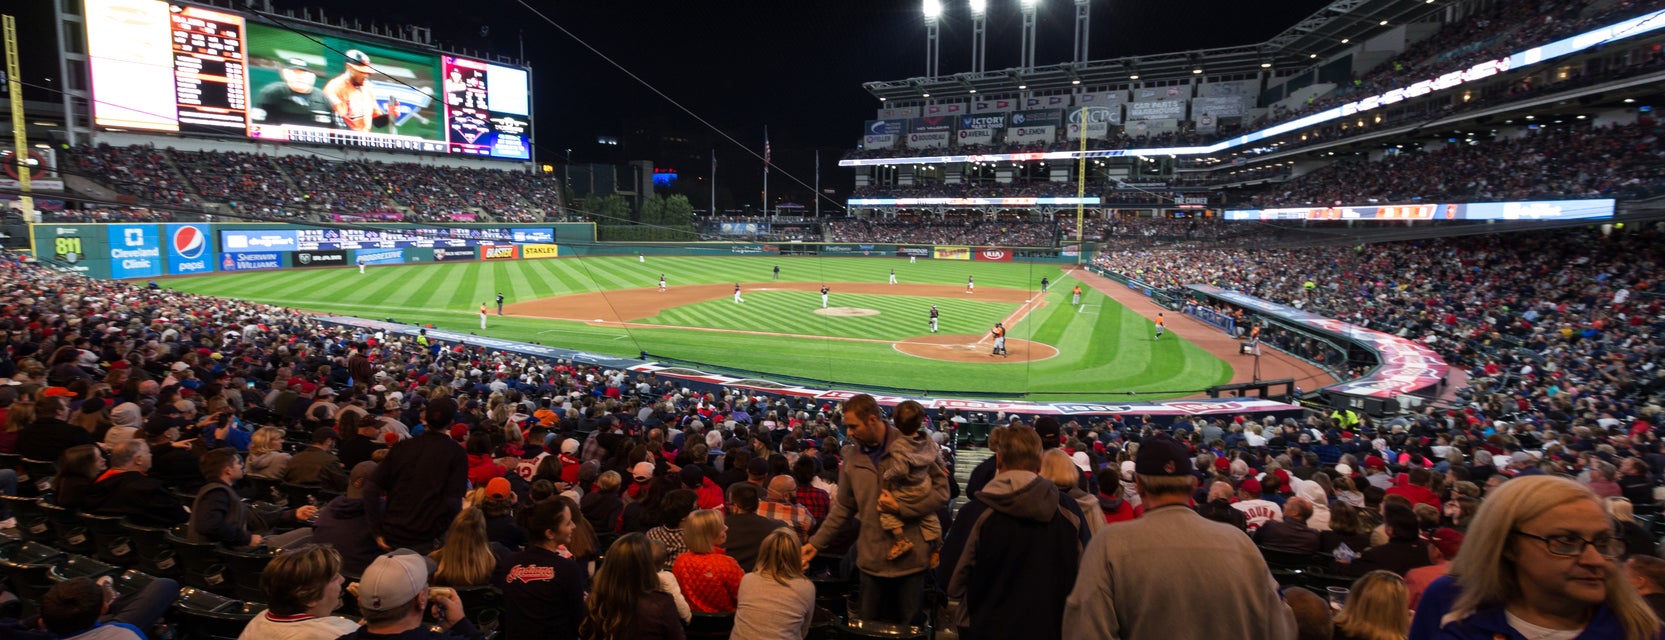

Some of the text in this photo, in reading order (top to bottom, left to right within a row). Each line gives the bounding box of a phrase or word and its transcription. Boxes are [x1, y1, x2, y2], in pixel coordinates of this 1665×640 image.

[1132, 107, 1181, 116] WAREHOUSE
[55, 237, 82, 254] 811
[111, 248, 160, 258] Cleveland
[122, 258, 152, 269] Clinic
[178, 260, 204, 272] pepsi
[506, 564, 556, 583] Indians
